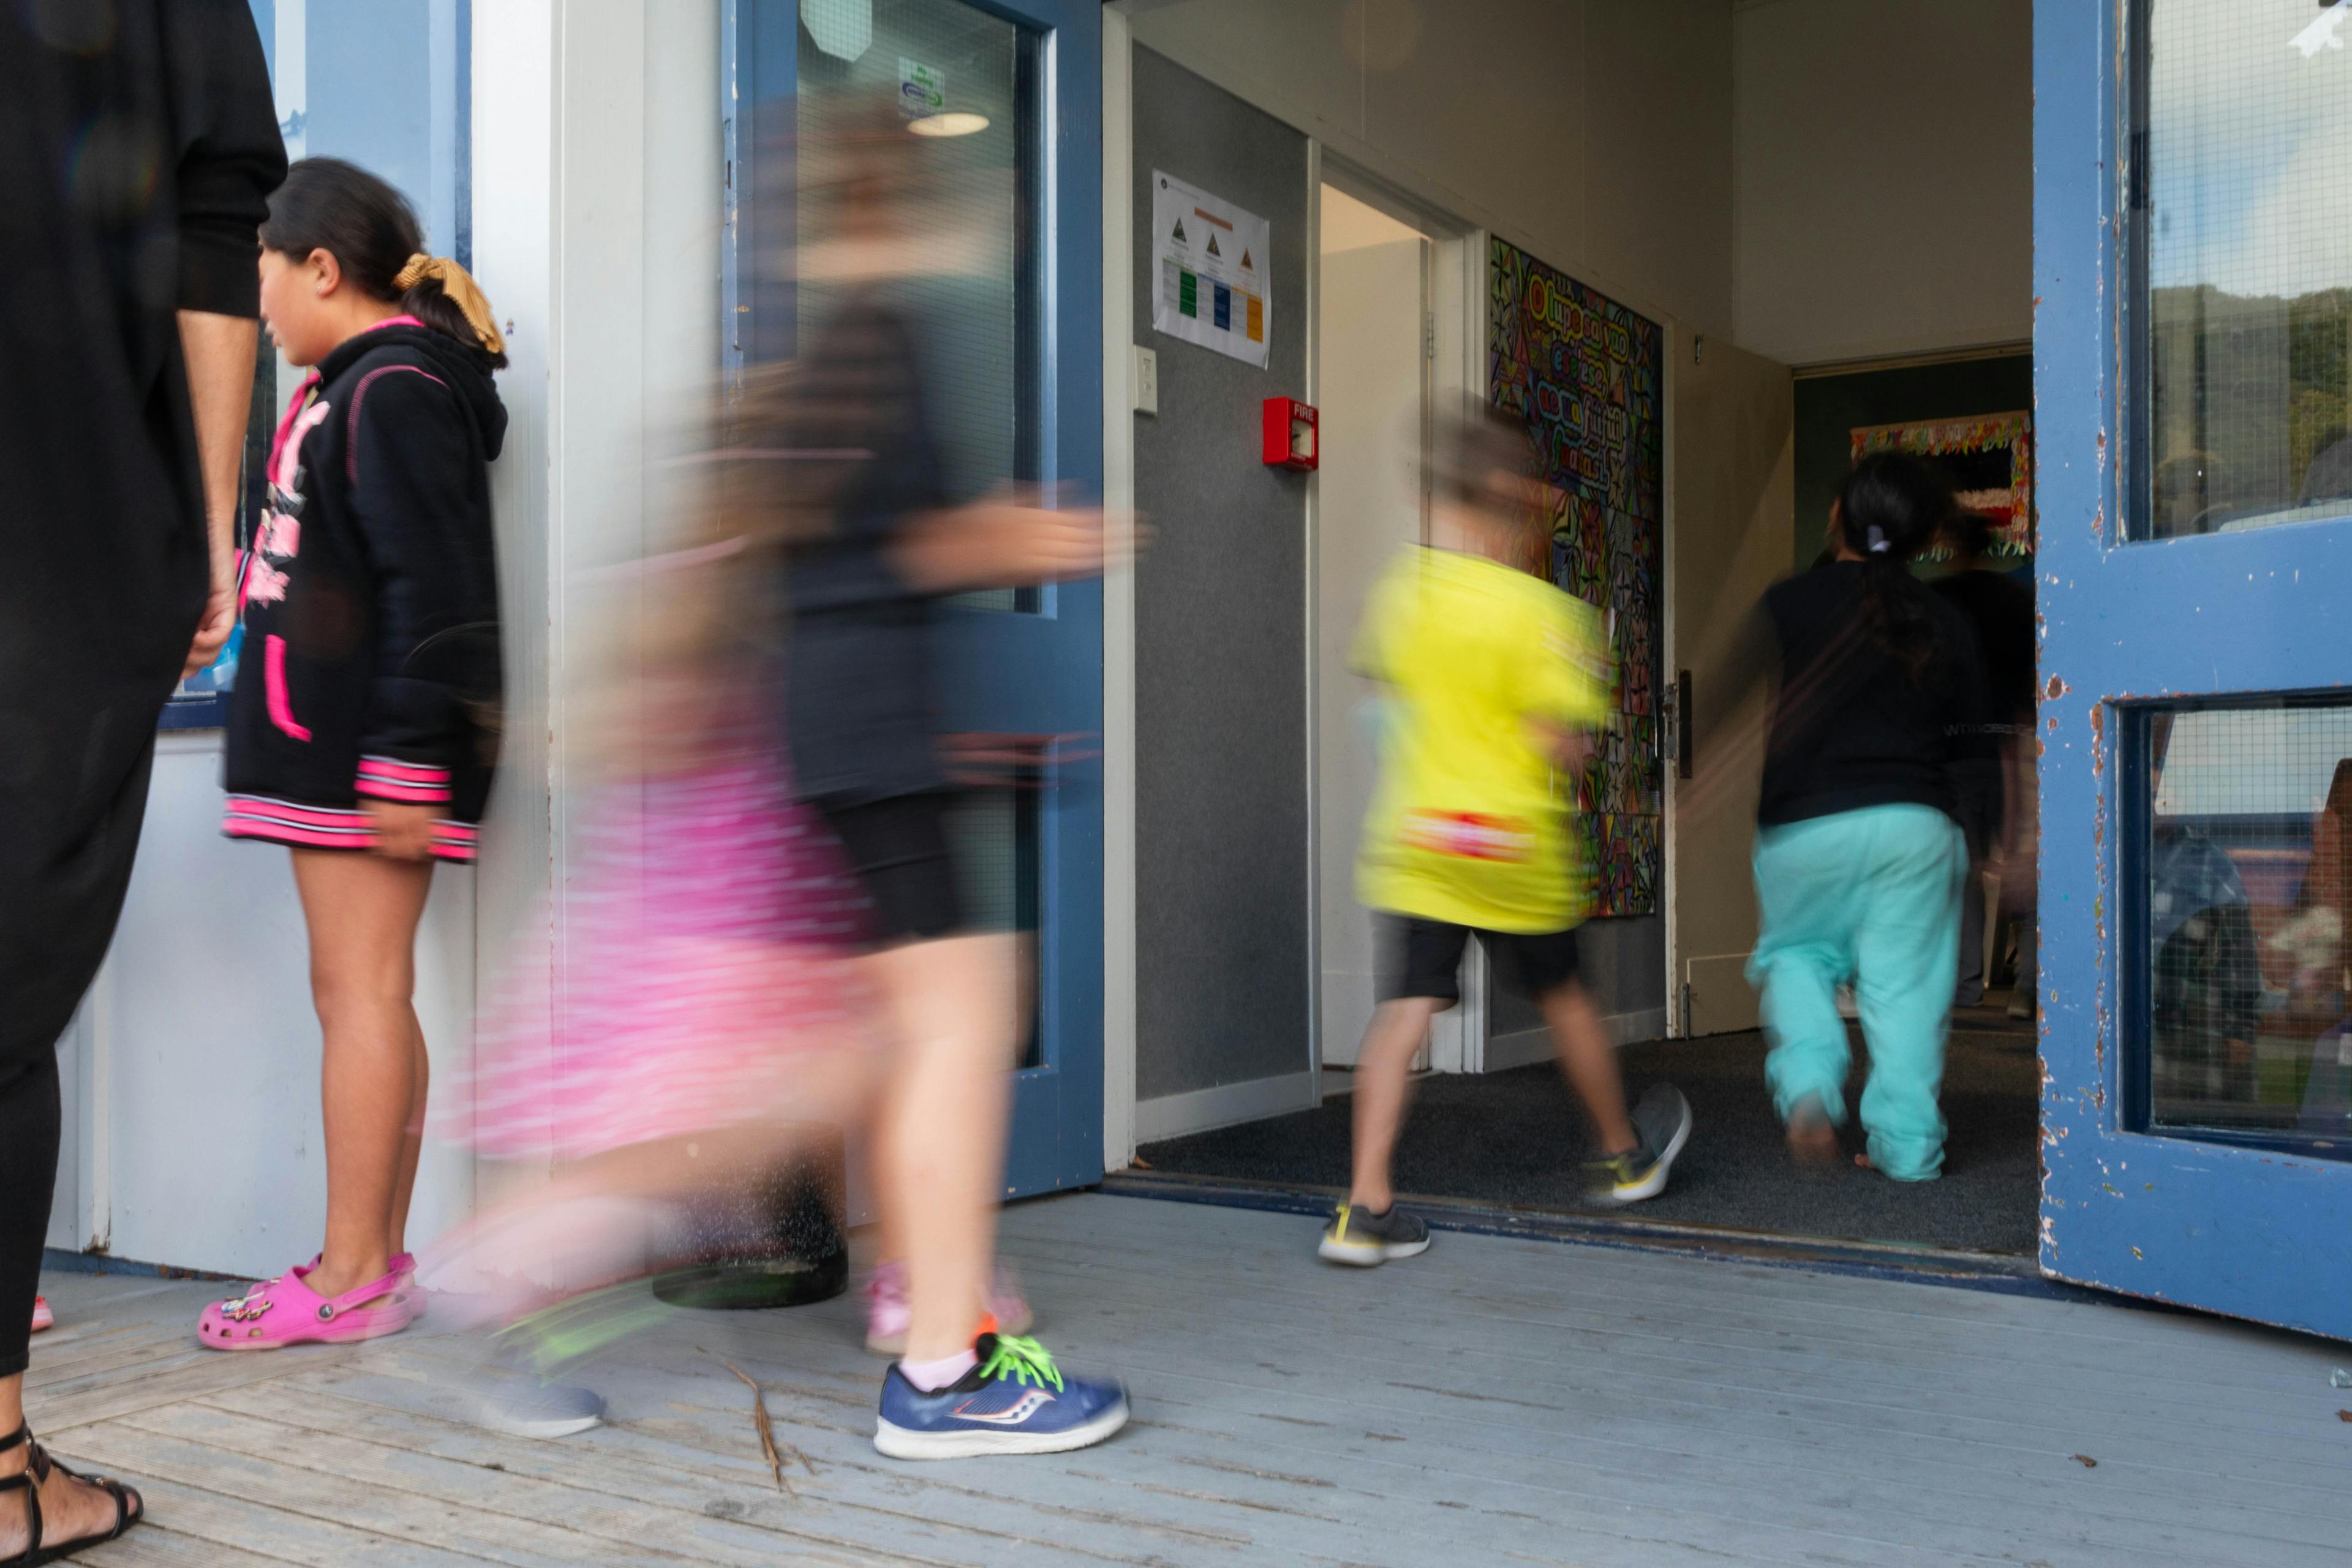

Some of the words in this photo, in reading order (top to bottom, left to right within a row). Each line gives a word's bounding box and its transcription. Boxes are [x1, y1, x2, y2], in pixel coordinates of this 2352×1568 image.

[1532, 282, 1544, 312] O
[1548, 287, 1580, 336] lupe
[1583, 315, 1600, 343] sa
[1603, 325, 1627, 356] vao
[1294, 402, 1314, 423] FIRE
[1583, 398, 1619, 445] fuifui
